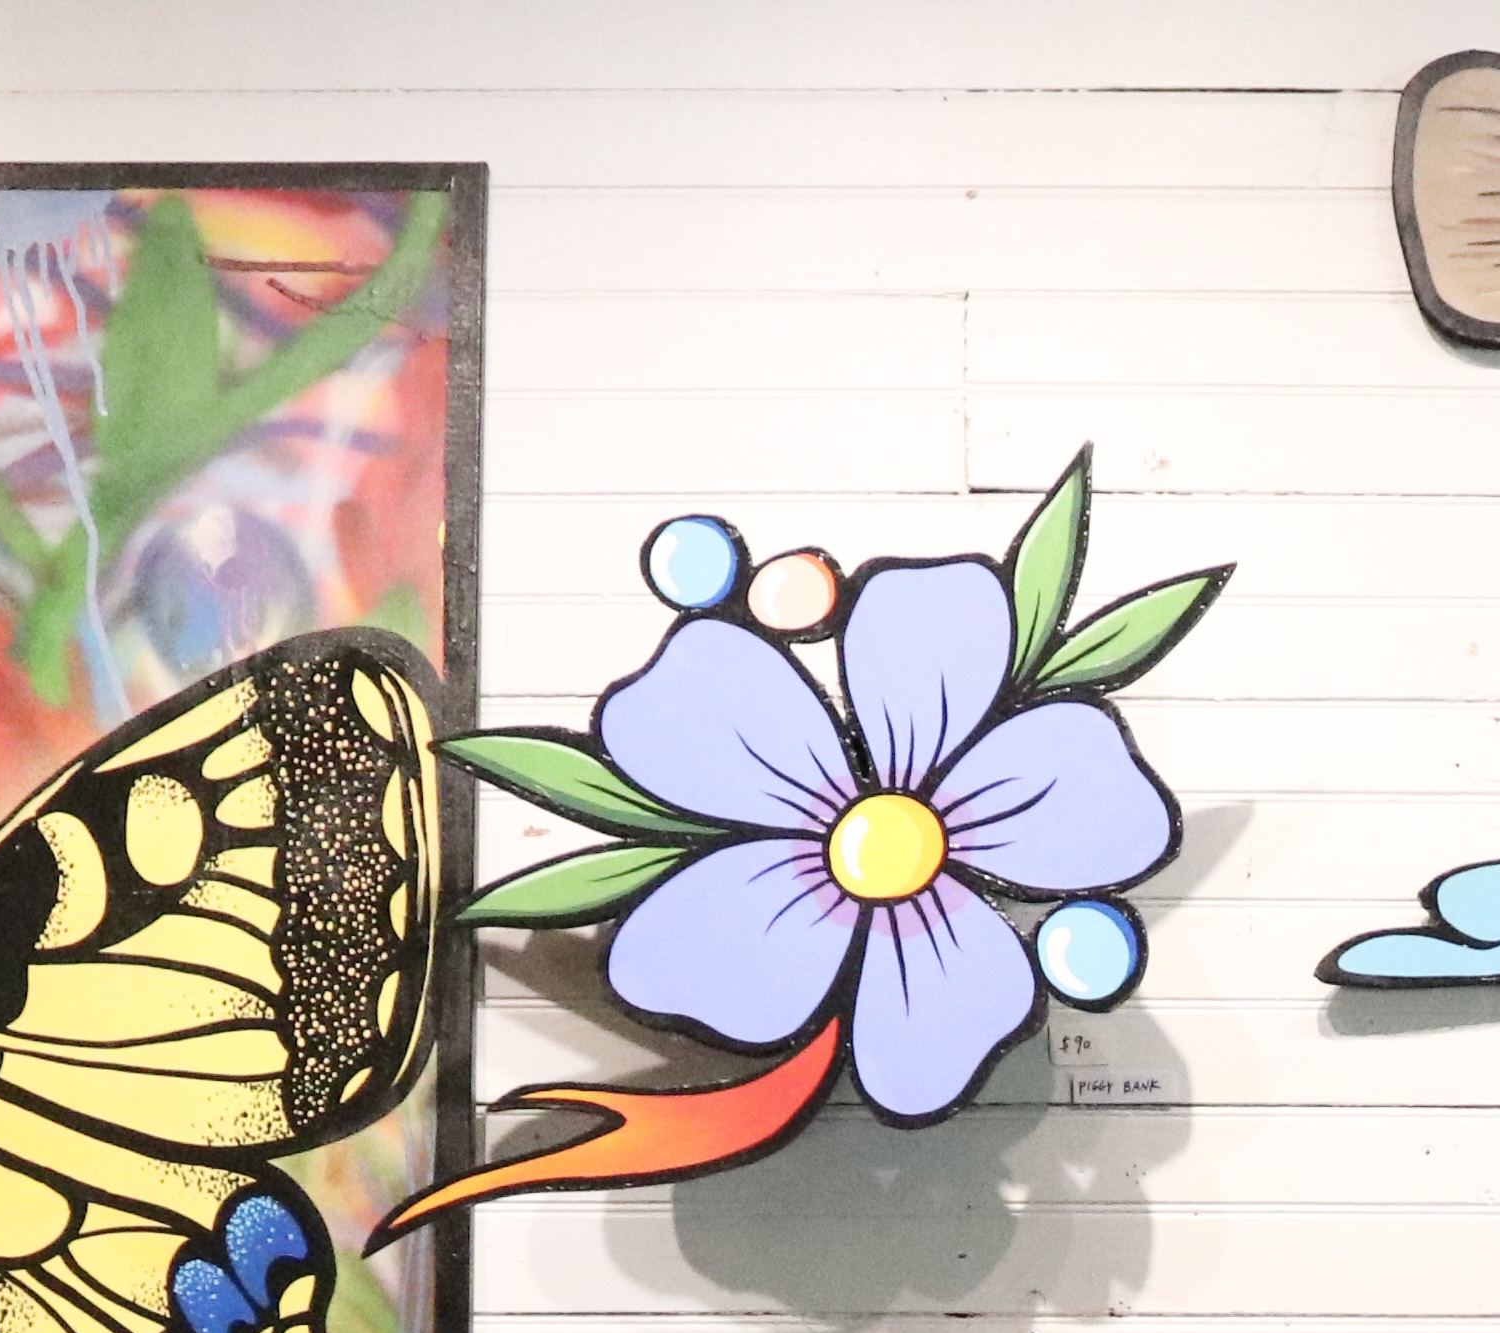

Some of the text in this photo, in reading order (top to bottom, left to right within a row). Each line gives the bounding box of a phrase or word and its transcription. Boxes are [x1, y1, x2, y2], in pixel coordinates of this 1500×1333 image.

[1059, 1035, 1091, 1054] $90
[1078, 1079, 1161, 1095] PIGGY BANK
